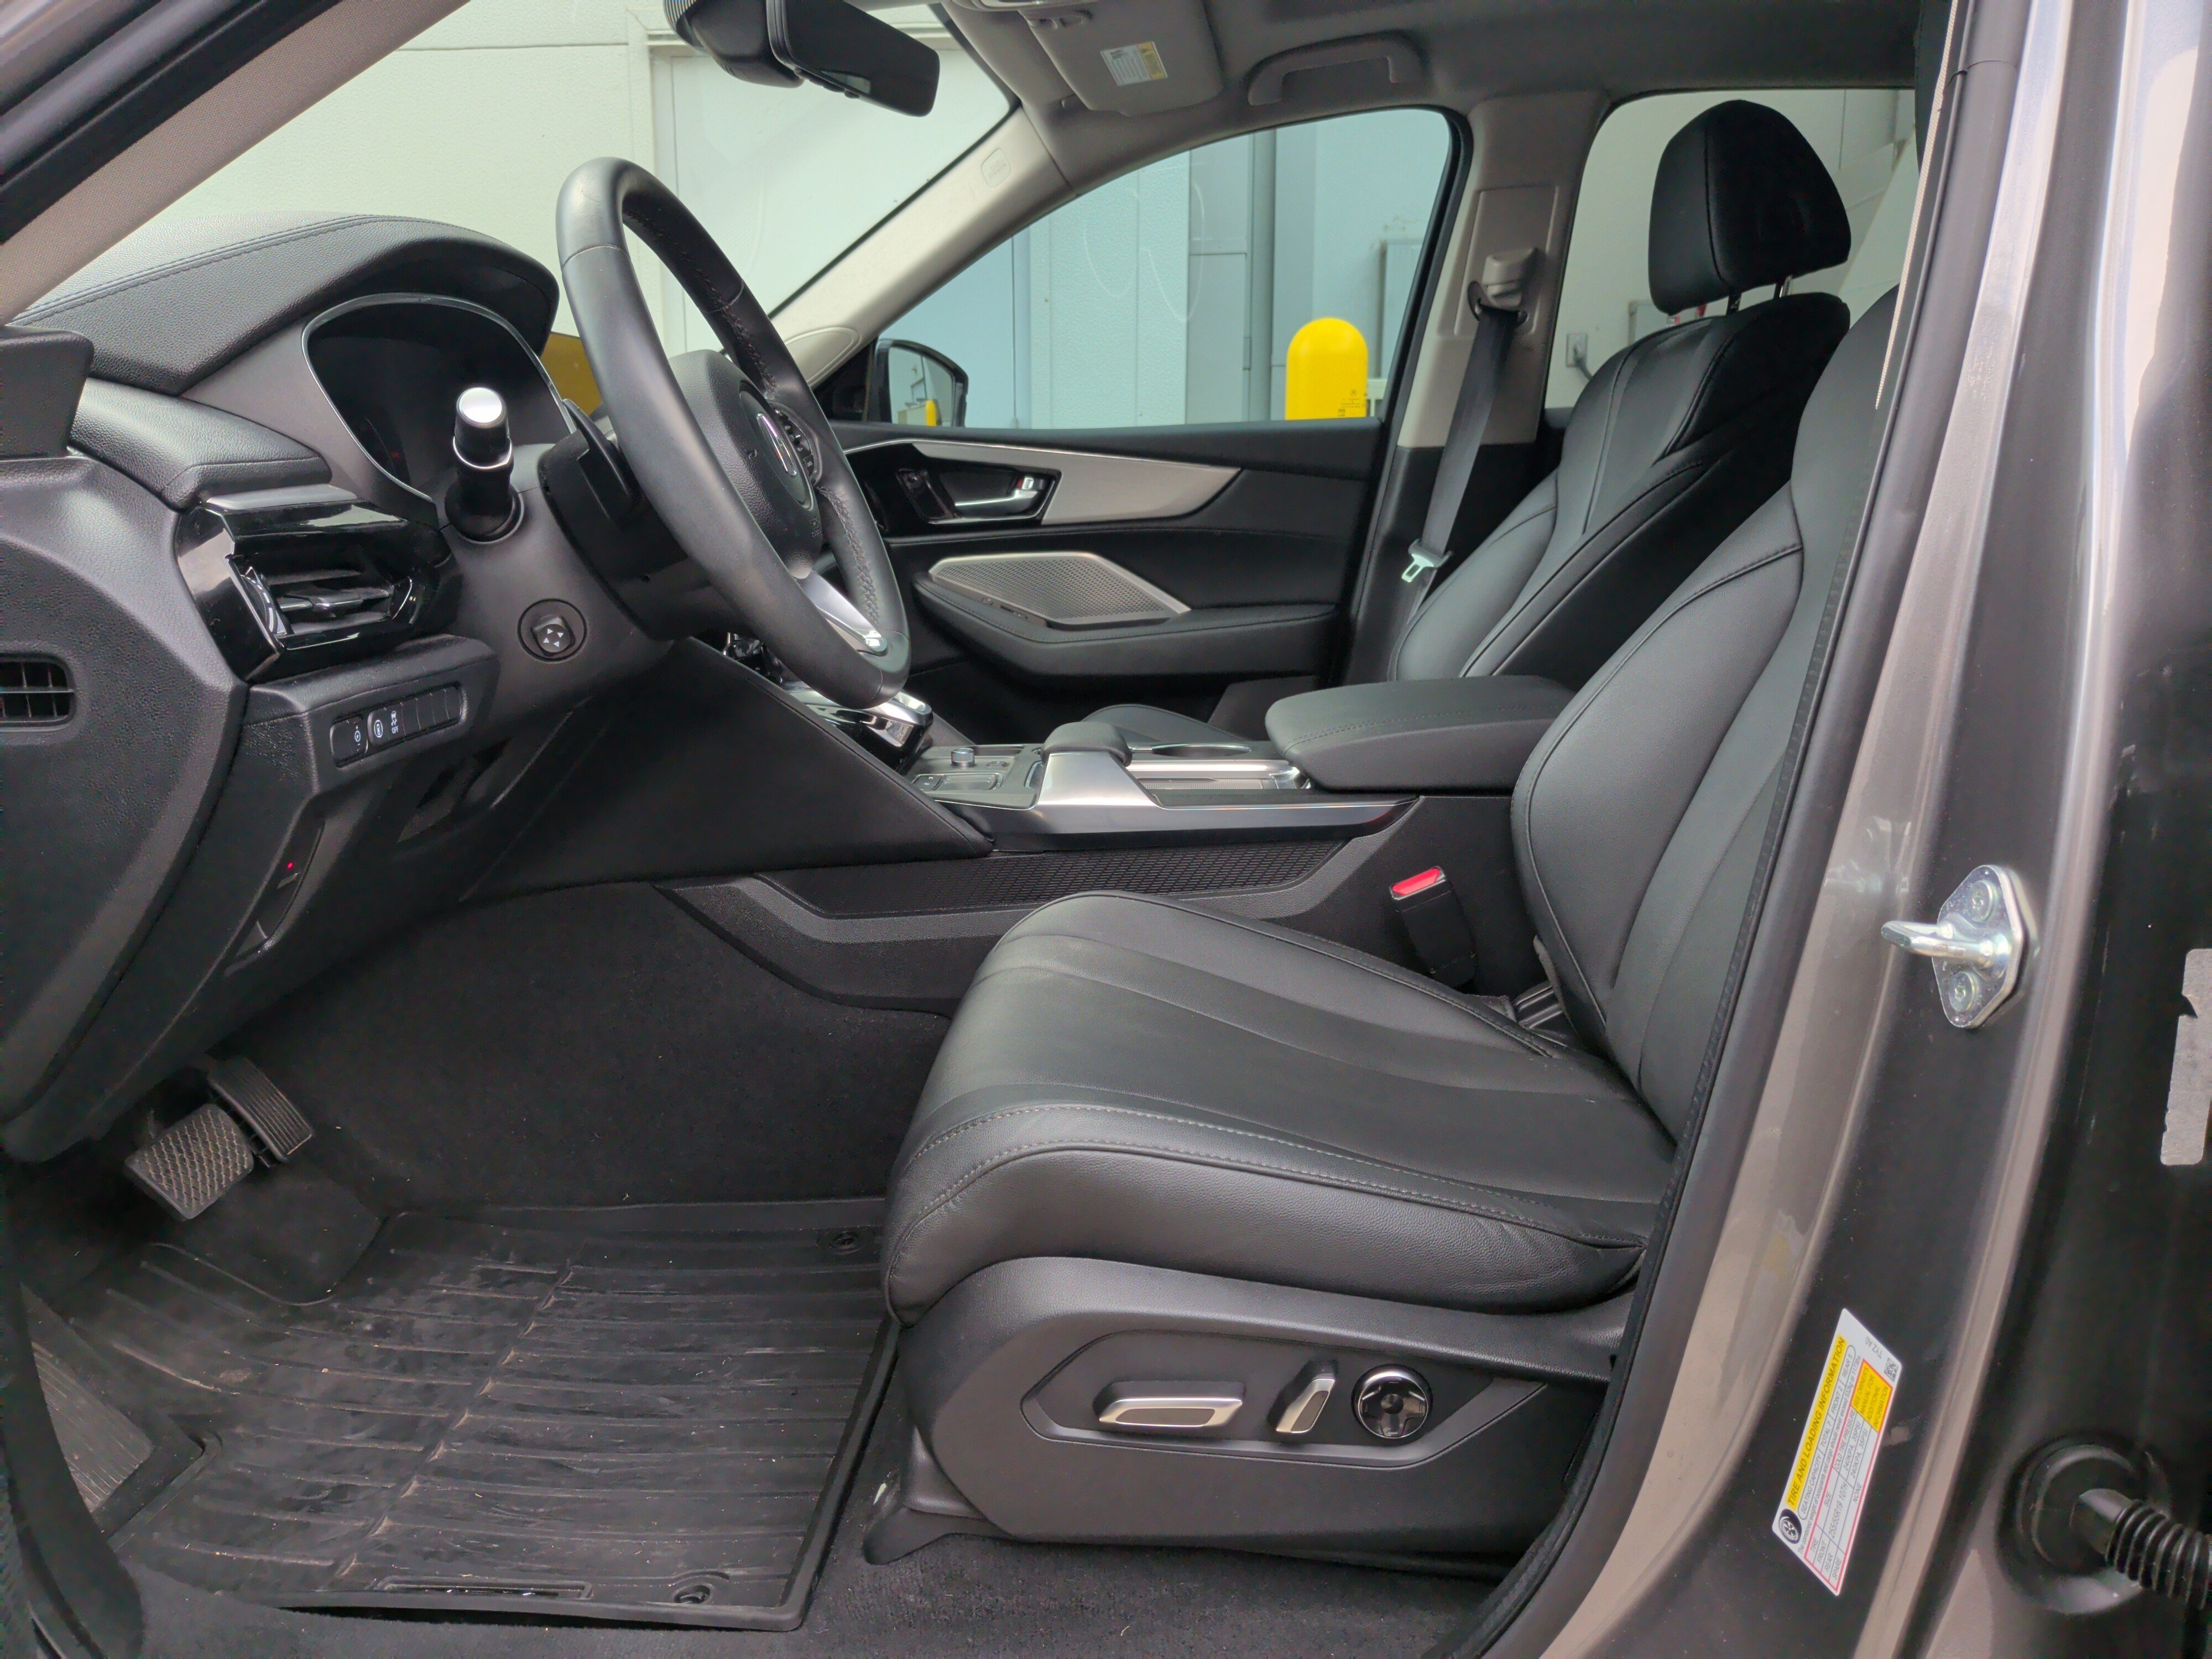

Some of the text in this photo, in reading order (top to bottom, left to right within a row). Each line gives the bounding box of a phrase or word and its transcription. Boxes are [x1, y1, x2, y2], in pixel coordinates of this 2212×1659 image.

[1787, 1336, 1845, 1507] TIRE AND LOADING INFORMATION
[1800, 1485, 1813, 1515] SEATING
[1808, 1453, 1822, 1486] CAPACITY
[1820, 1426, 1830, 1448] TOTAL
[1830, 1390, 1841, 1415] FRONT
[1841, 1358, 1851, 1379] REAR
[1852, 1392, 1860, 1409] SEE
[1859, 1374, 1875, 1415] MANUAL FOR
[1872, 1384, 1888, 1428] INFORMATION
[1809, 1536, 1818, 1554] TIRE
[1834, 1451, 1843, 1470] COLD
[1842, 1408, 1855, 1441] PRESSURE
[1816, 1540, 1827, 1564] FRONT
[1851, 1420, 1861, 1442] 35PSI
[1824, 1552, 1833, 1573] REAR
[1858, 1427, 1868, 1450] 35PSI
[1827, 1480, 1848, 1540] 255/55R19 107H
[1831, 1481, 1862, 1581] SPARE NONE
